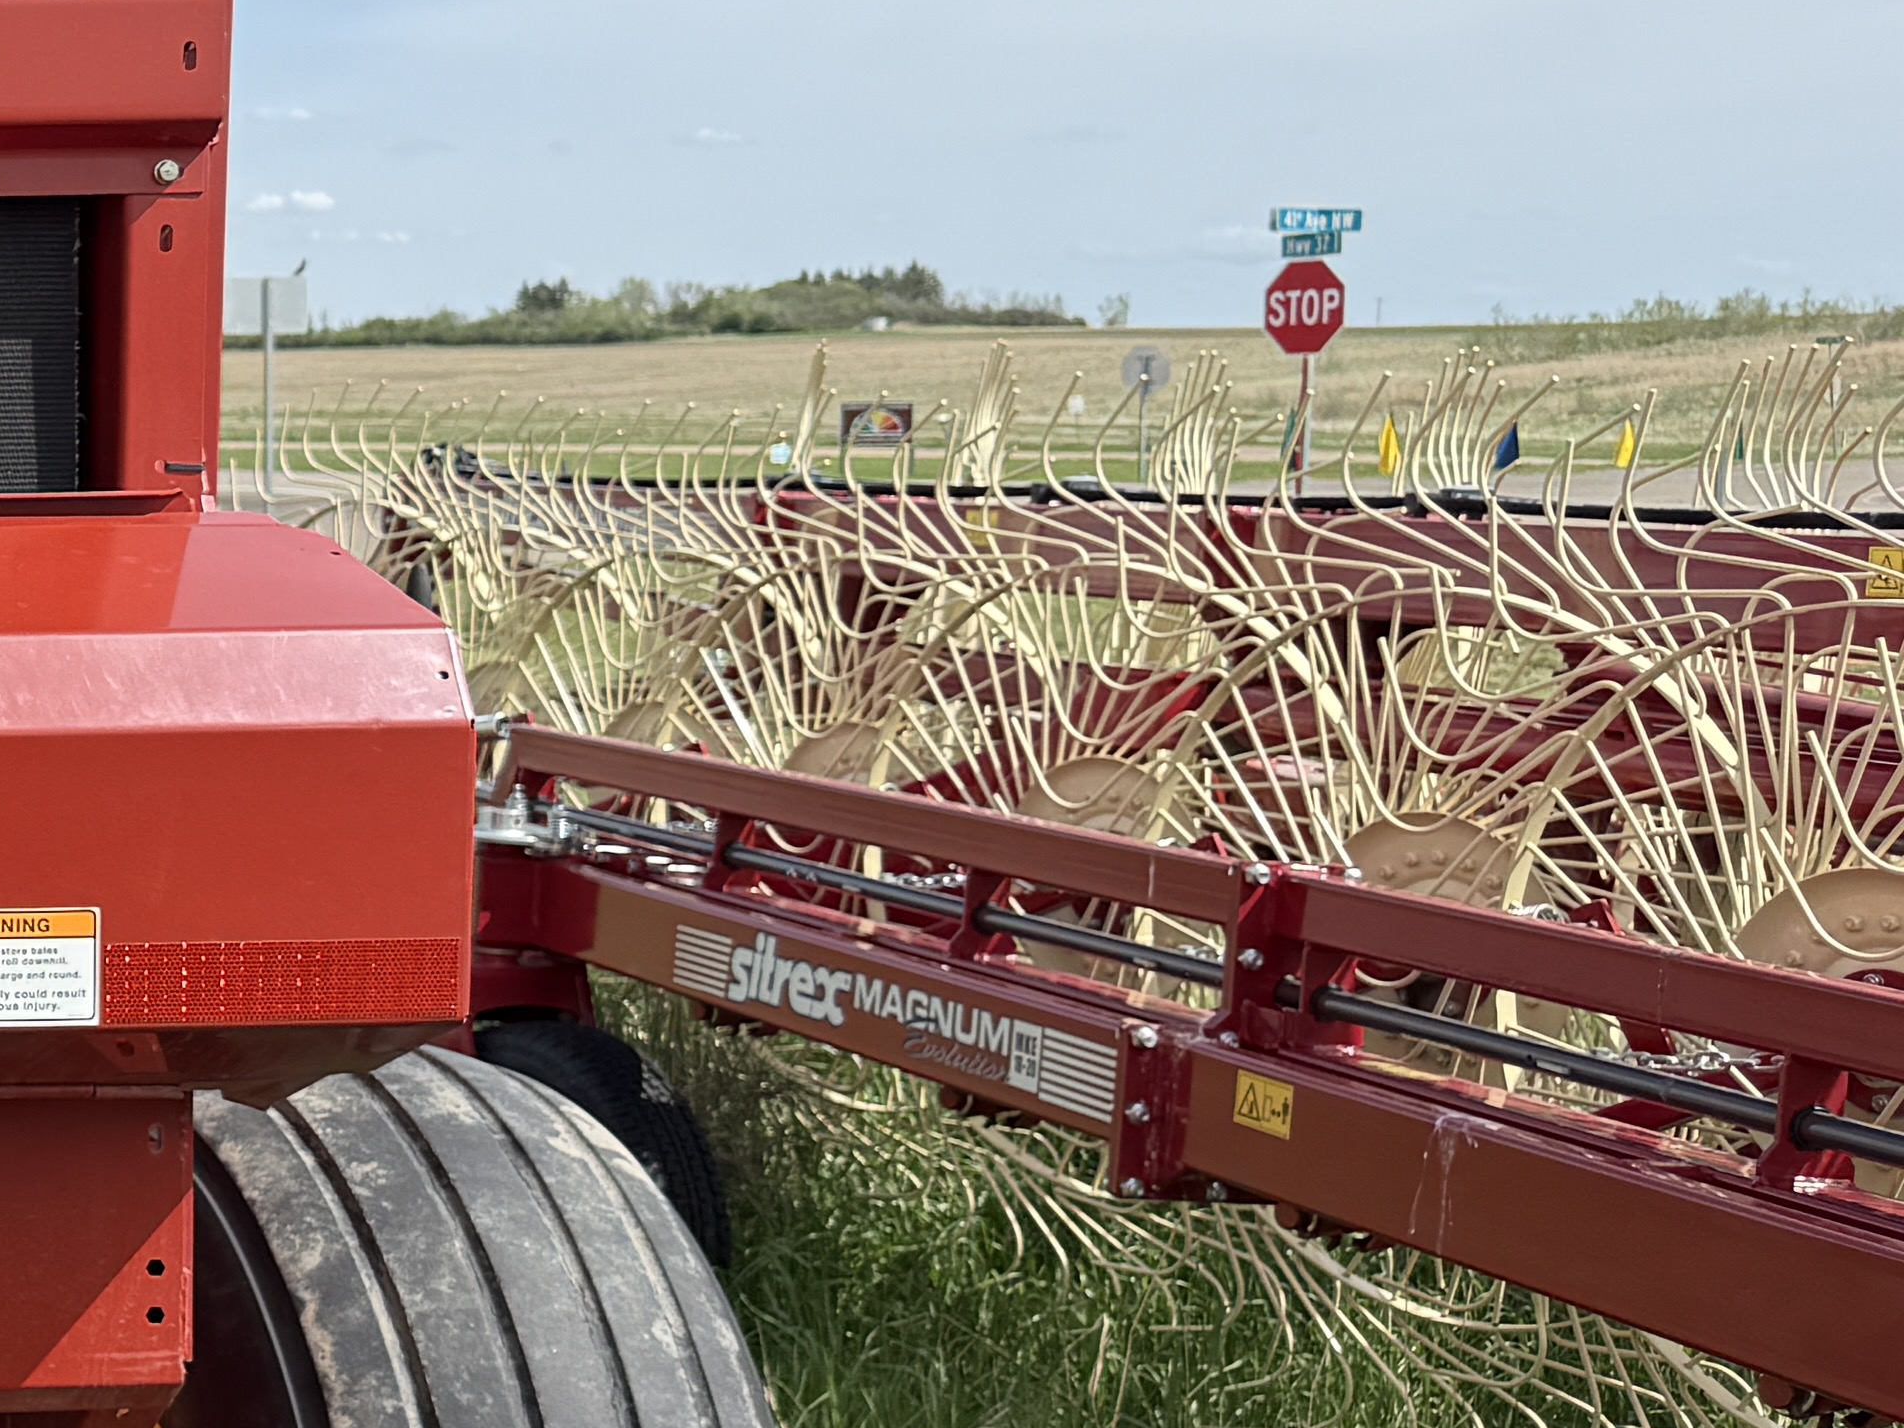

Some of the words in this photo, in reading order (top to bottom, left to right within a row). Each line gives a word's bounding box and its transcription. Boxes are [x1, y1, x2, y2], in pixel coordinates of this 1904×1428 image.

[1304, 211, 1327, 230] Ave
[1332, 212, 1354, 229] NW
[1268, 288, 1340, 328] STOP
[31, 947, 58, 955] bales
[27, 971, 45, 979] and
[49, 971, 82, 979] round.
[14, 990, 47, 999] could
[52, 989, 87, 998] result
[728, 931, 851, 1026] sitrex
[854, 972, 1011, 1057] MAGNUM
[23, 1002, 61, 1012] injury.
